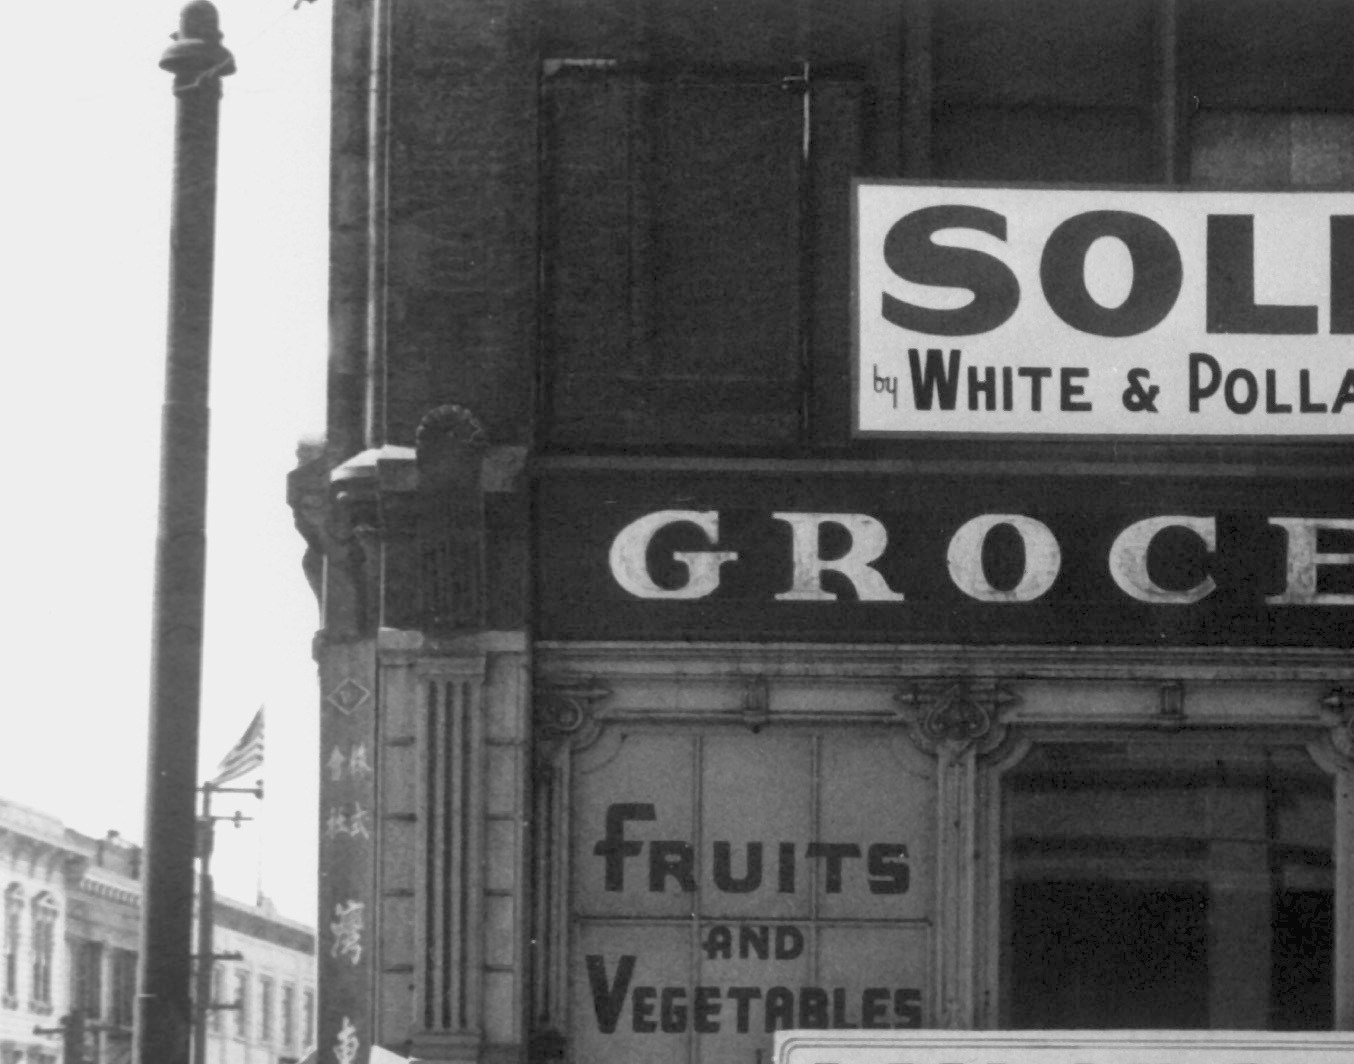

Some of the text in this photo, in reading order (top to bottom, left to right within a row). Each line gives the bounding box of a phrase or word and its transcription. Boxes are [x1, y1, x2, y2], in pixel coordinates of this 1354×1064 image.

[873, 364, 898, 409] by
[908, 348, 1093, 413] WHITE
[1122, 367, 1161, 415] &
[701, 924, 805, 961] AND
[585, 954, 923, 1034] VEGETABLES
